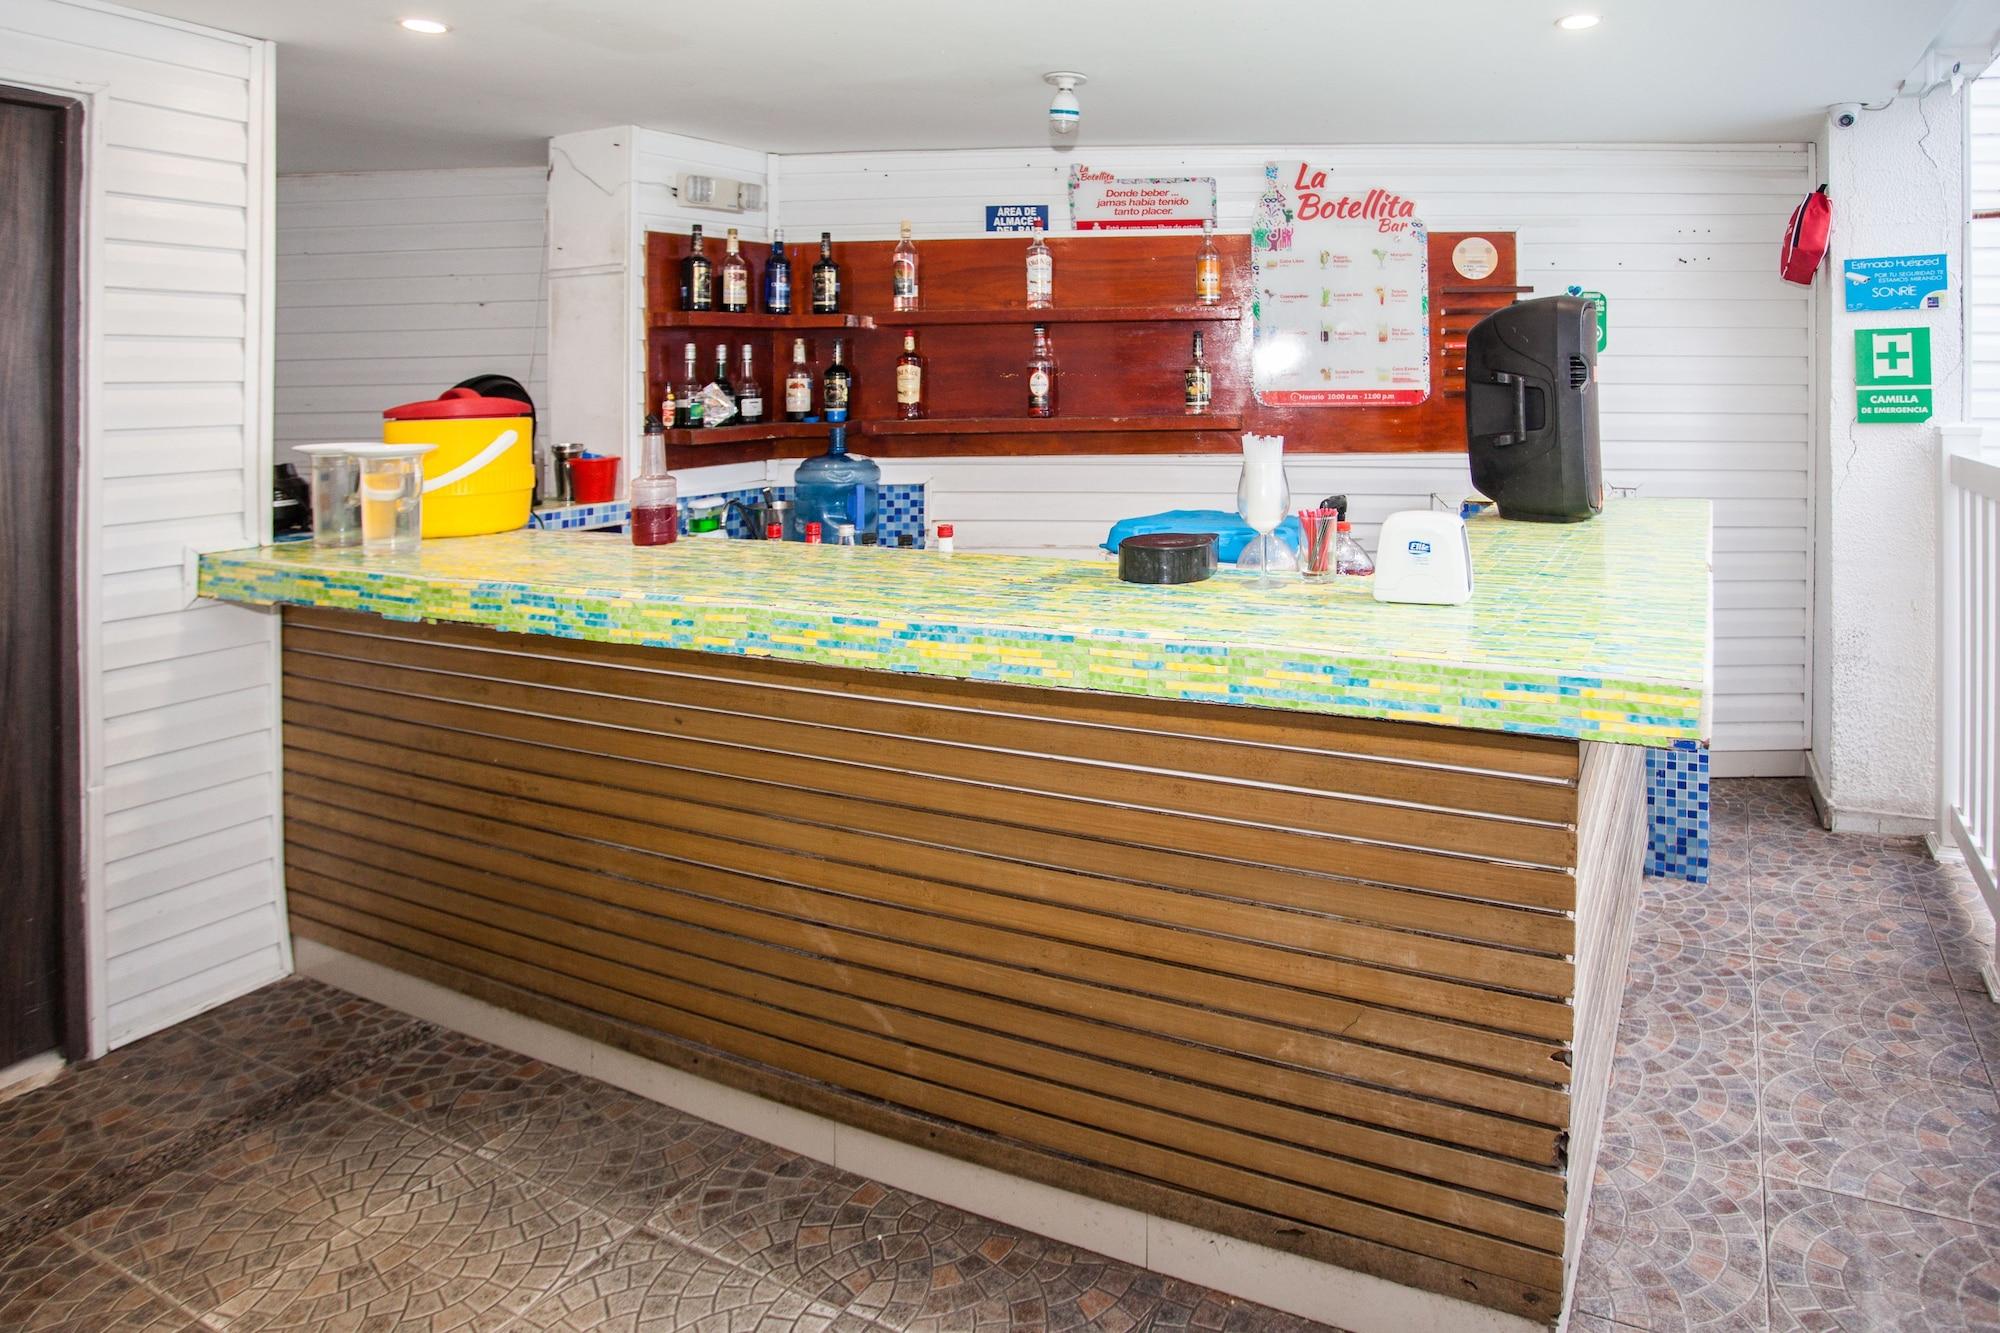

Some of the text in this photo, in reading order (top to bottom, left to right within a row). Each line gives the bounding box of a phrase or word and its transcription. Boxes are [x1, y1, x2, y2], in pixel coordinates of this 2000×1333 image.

[1080, 165, 1089, 173] La
[1295, 163, 1327, 191] La
[1106, 189, 1138, 198] Donde
[1141, 189, 1169, 197] beber
[1158, 198, 1189, 206] tenido
[1297, 189, 1415, 221] Botellita
[1024, 206, 1037, 216] DE
[1114, 207, 1173, 217] tanto placer.
[1378, 218, 1408, 233] Bar
[1852, 260, 1894, 270] Estimado
[1300, 393, 1324, 401] Horario
[1870, 395, 1919, 404] CAMILLA
[1874, 406, 1929, 414] EMERGENCIA
